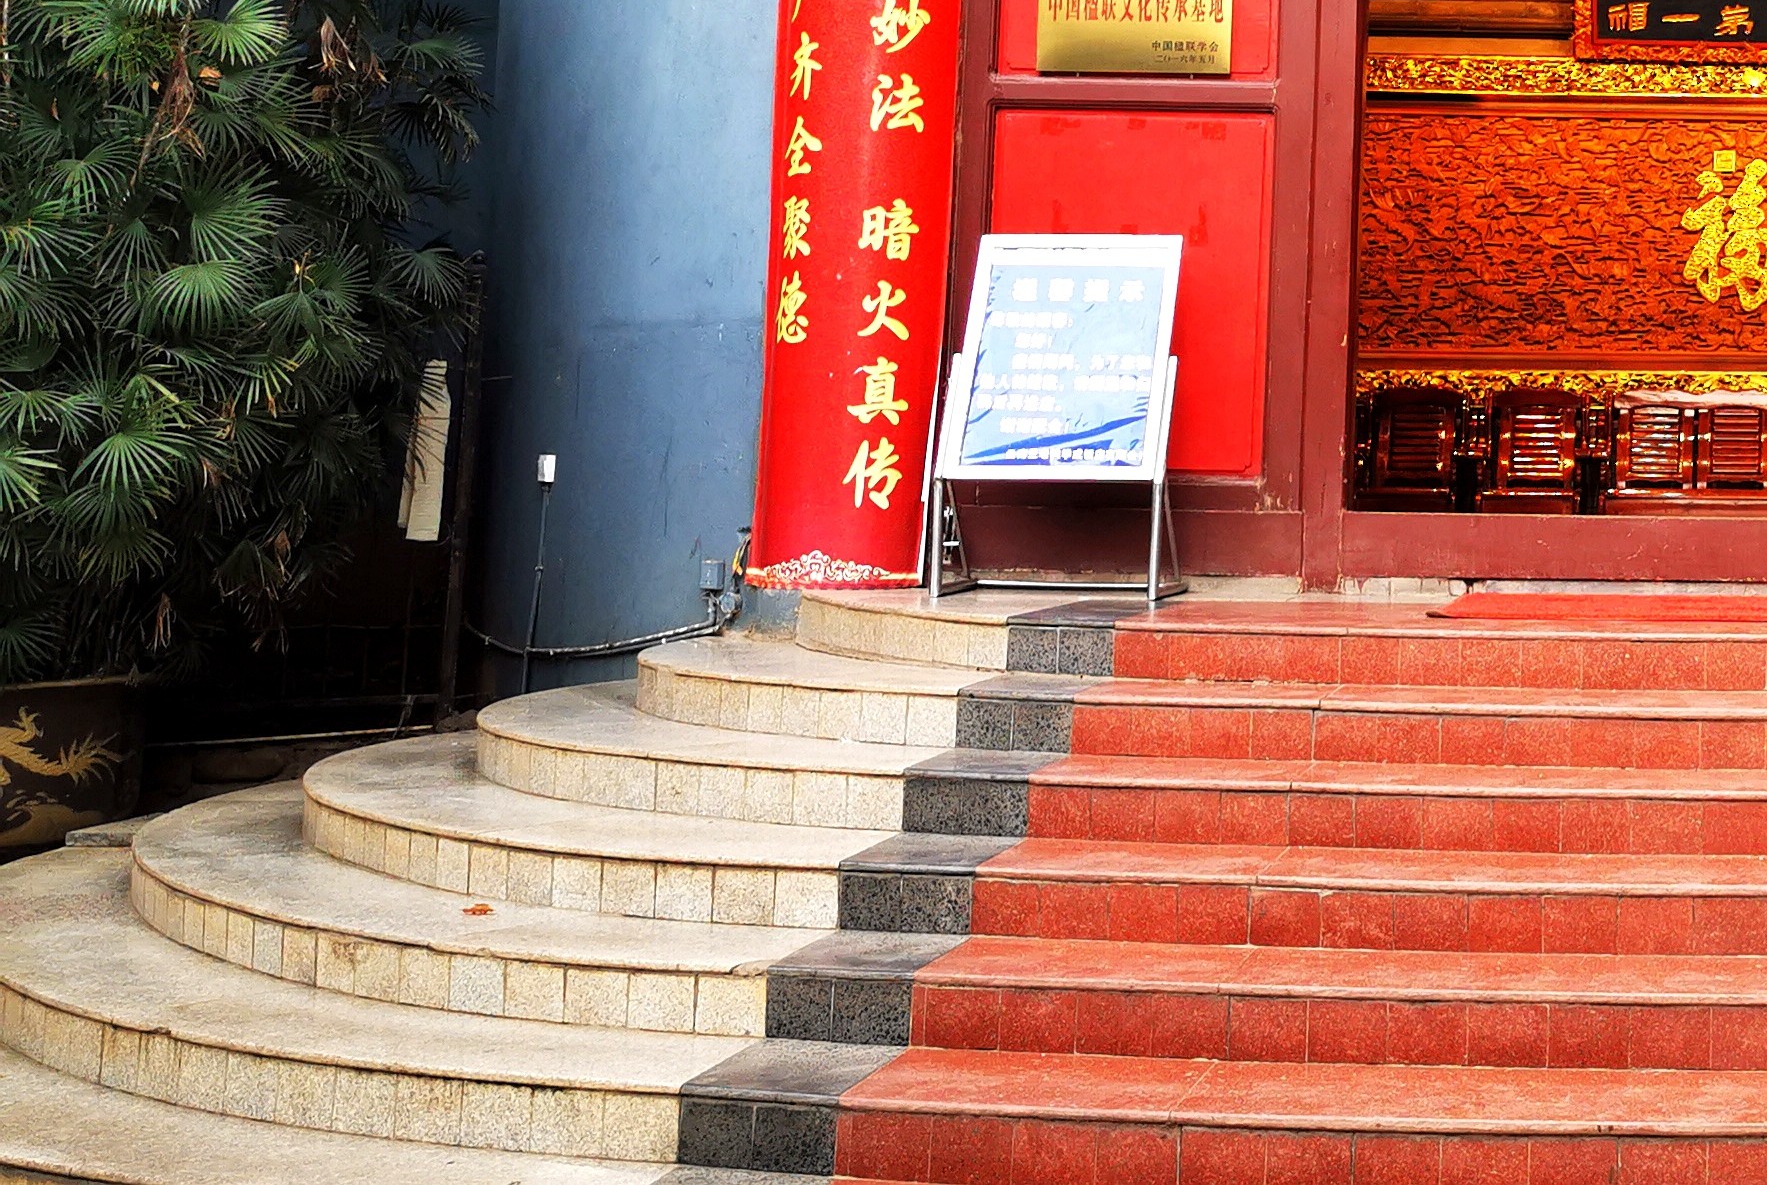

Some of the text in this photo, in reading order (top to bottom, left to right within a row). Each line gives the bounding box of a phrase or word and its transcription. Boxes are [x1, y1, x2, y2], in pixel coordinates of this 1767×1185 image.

[1151, 40, 1219, 53] 中国楹联学会
[842, 198, 920, 511] 暗火真传
